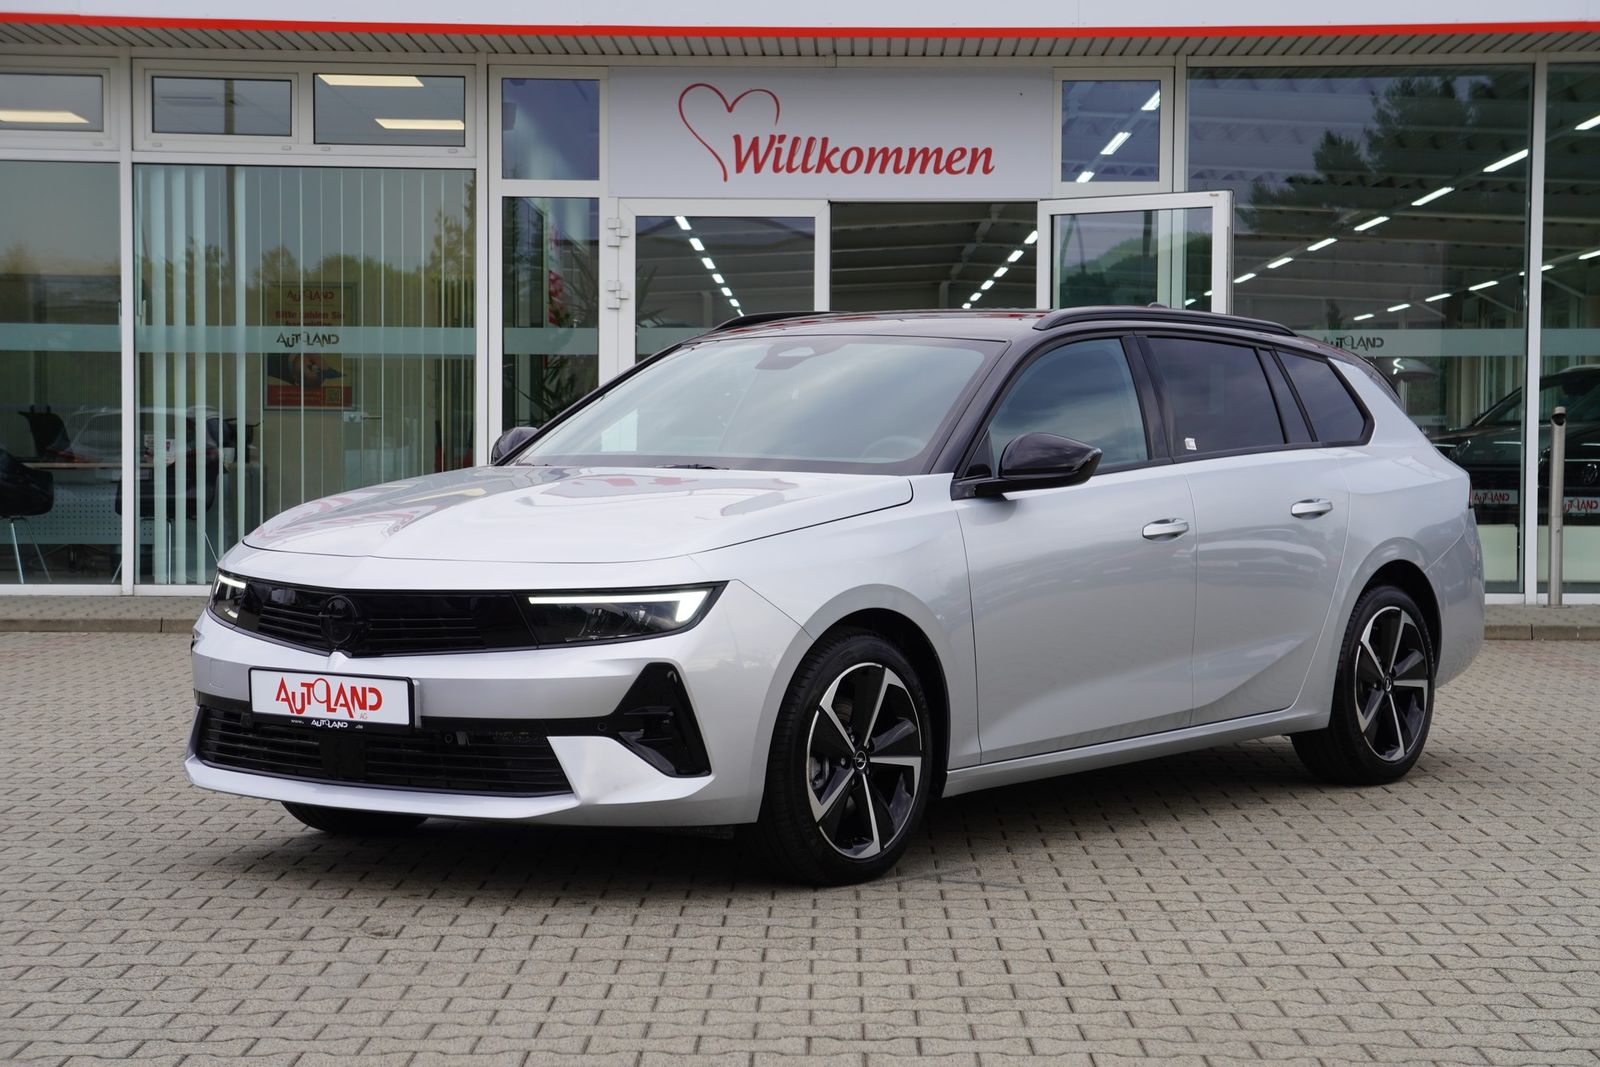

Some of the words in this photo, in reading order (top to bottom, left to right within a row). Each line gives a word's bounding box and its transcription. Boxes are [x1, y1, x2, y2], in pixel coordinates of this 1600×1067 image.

[732, 134, 995, 175] Willkommen
[1563, 497, 1599, 513] UTOLAND
[275, 676, 383, 719] AUTOLAND
[311, 718, 348, 729] AUTOLAND
